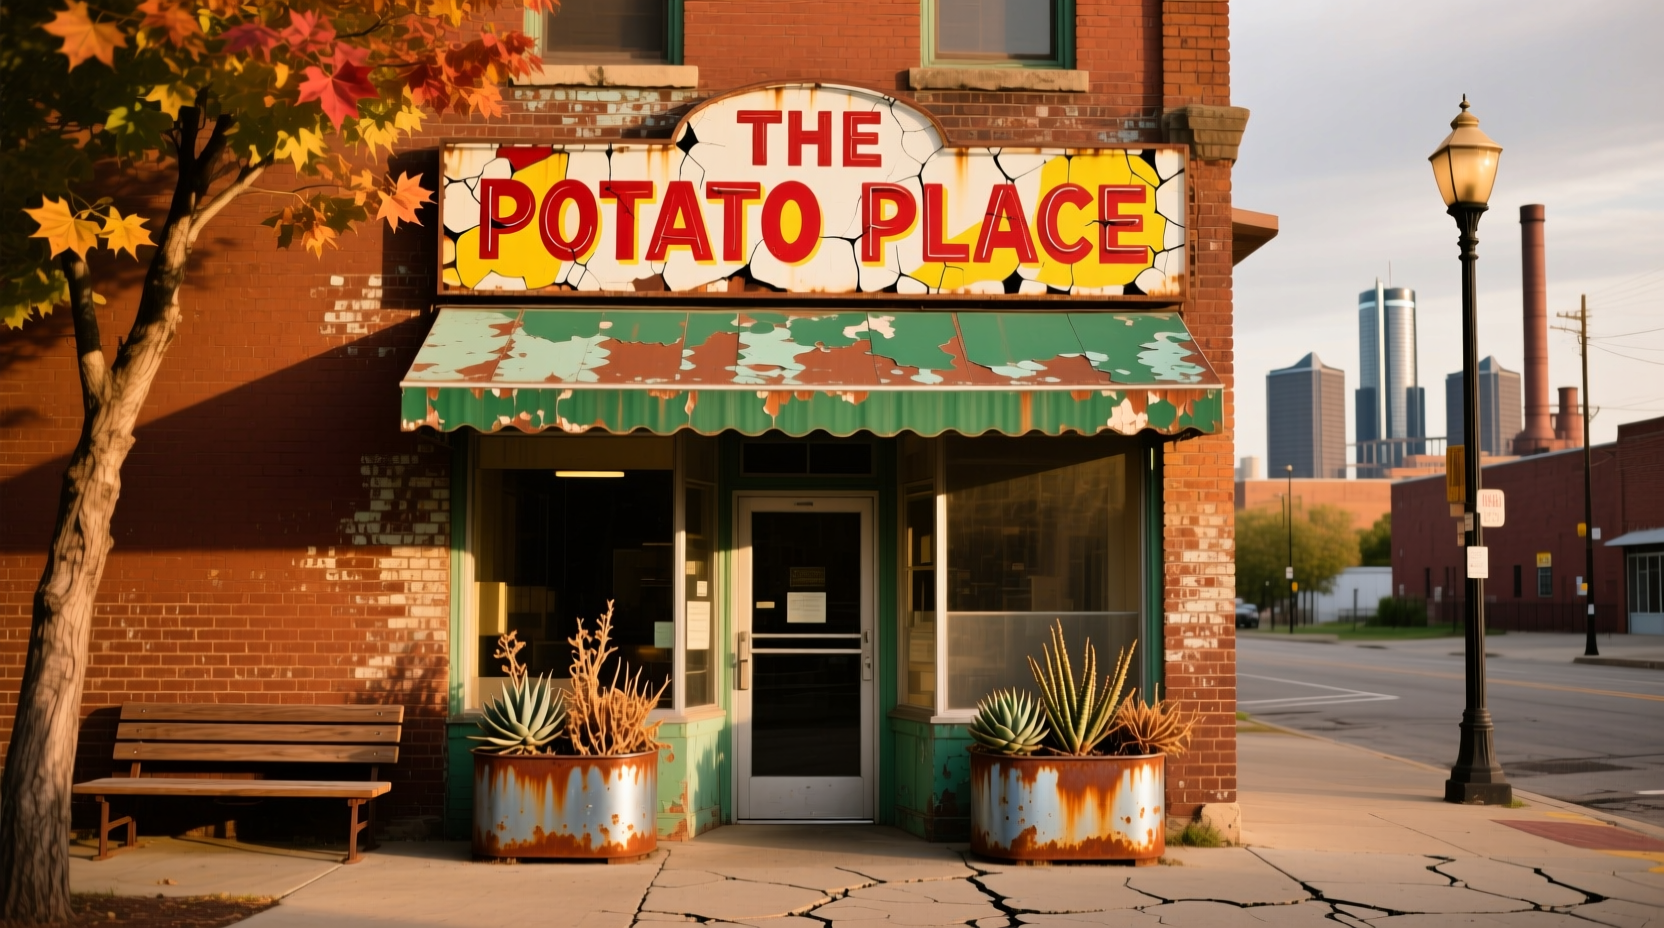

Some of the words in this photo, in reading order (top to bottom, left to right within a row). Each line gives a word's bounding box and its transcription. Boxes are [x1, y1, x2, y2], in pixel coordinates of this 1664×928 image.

[737, 110, 881, 167] THE
[479, 179, 820, 263] POTATO
[862, 182, 1148, 263] PLACE
